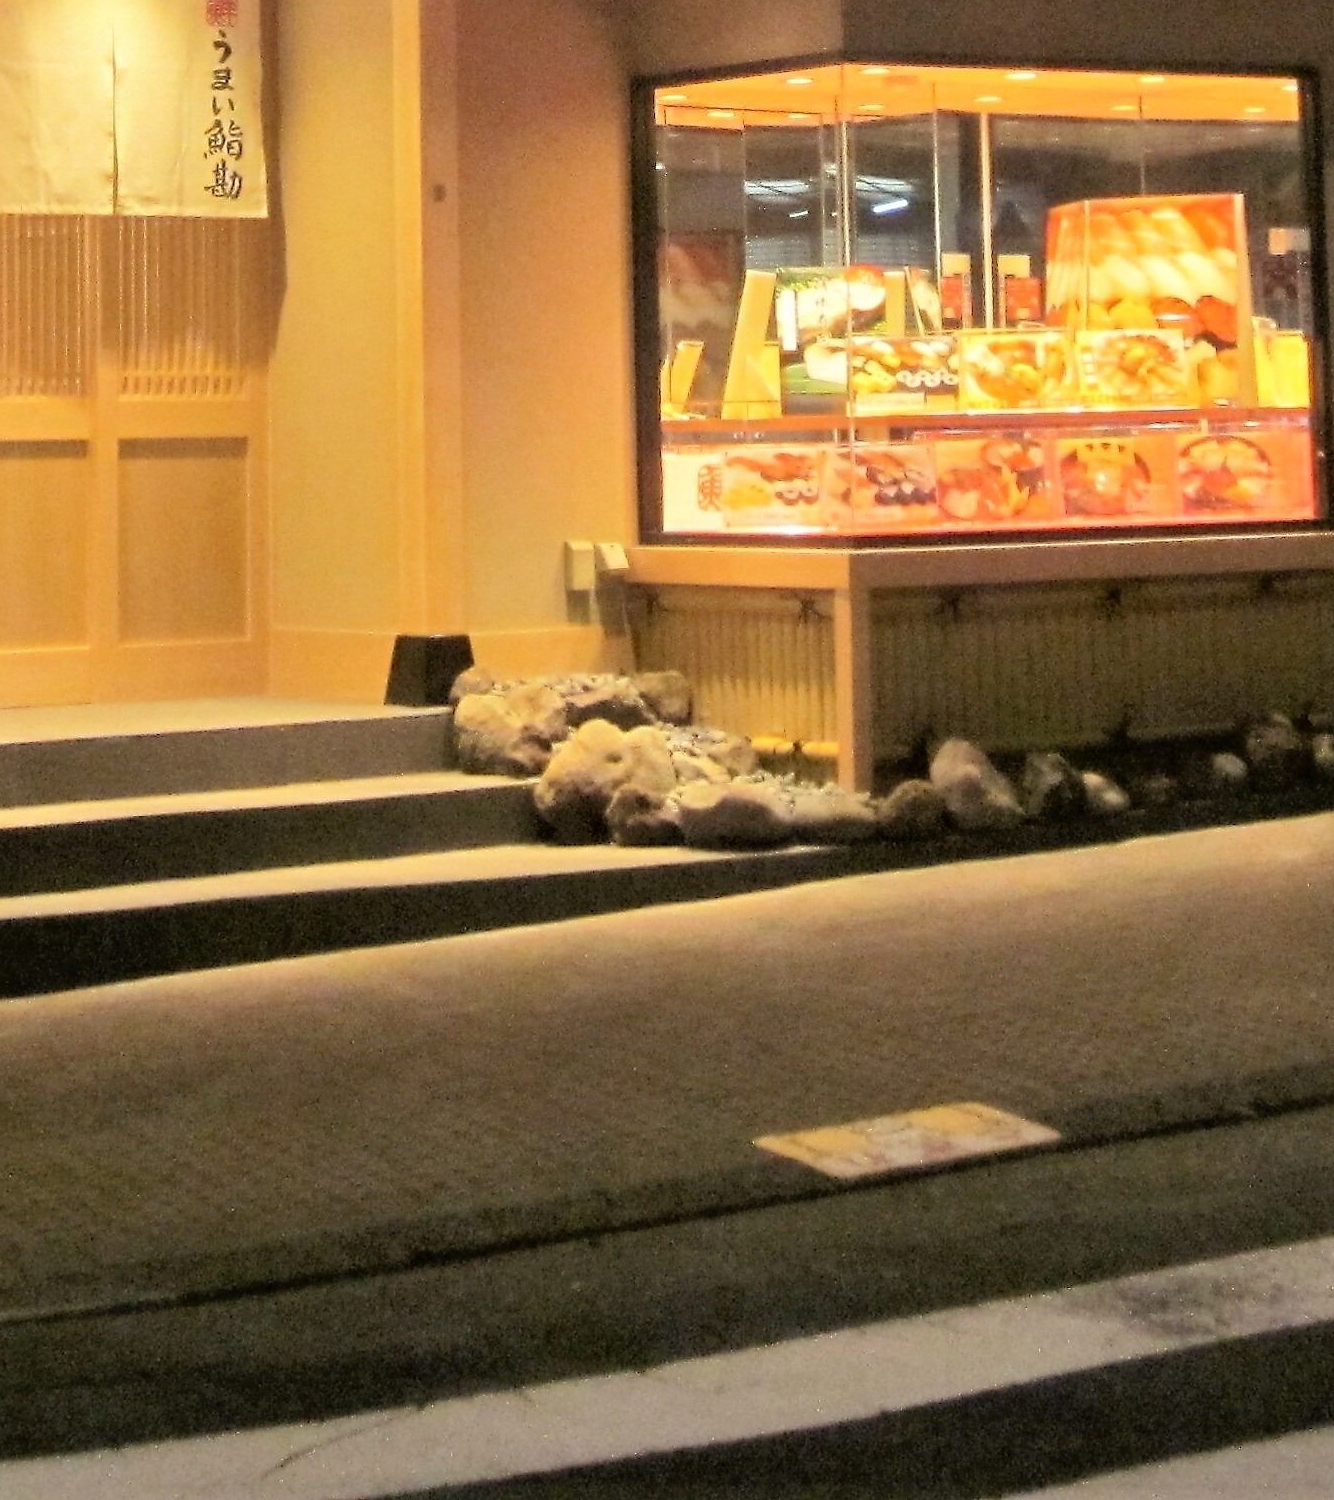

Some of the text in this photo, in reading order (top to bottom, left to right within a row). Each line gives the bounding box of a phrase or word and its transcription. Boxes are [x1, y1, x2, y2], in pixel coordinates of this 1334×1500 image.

[203, 30, 244, 201] うまい鮨勘
